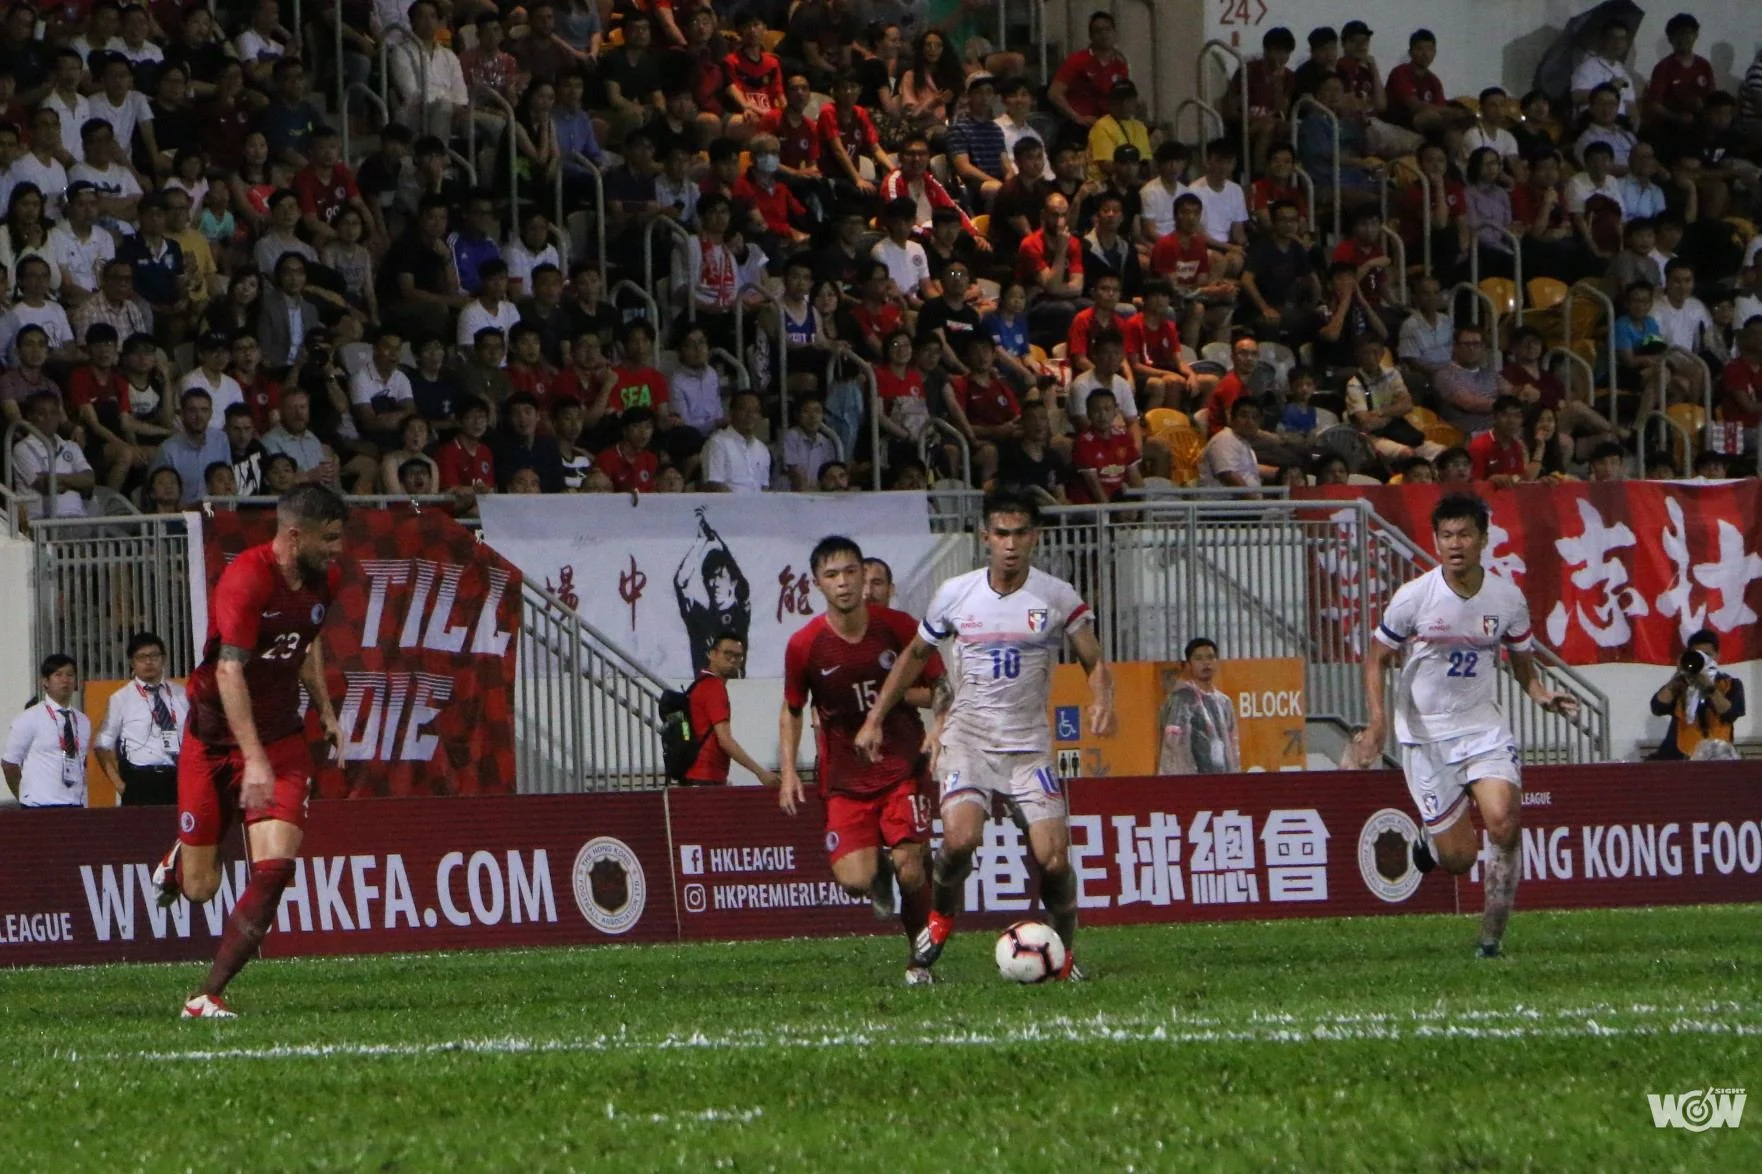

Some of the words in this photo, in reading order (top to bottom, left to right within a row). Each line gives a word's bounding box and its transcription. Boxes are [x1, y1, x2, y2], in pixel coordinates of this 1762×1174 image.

[1219, 0, 1250, 25] 24
[360, 558, 511, 658] TILL
[261, 632, 301, 660] 23
[990, 648, 1021, 679] 10
[1447, 651, 1478, 677] 22
[852, 680, 880, 712] 15
[1239, 689, 1303, 718] BLOCK
[328, 671, 455, 761] DIE
[710, 846, 796, 873] HKLEAGUE
[1470, 826, 1573, 883] HNG
[1582, 823, 1683, 878] KONG
